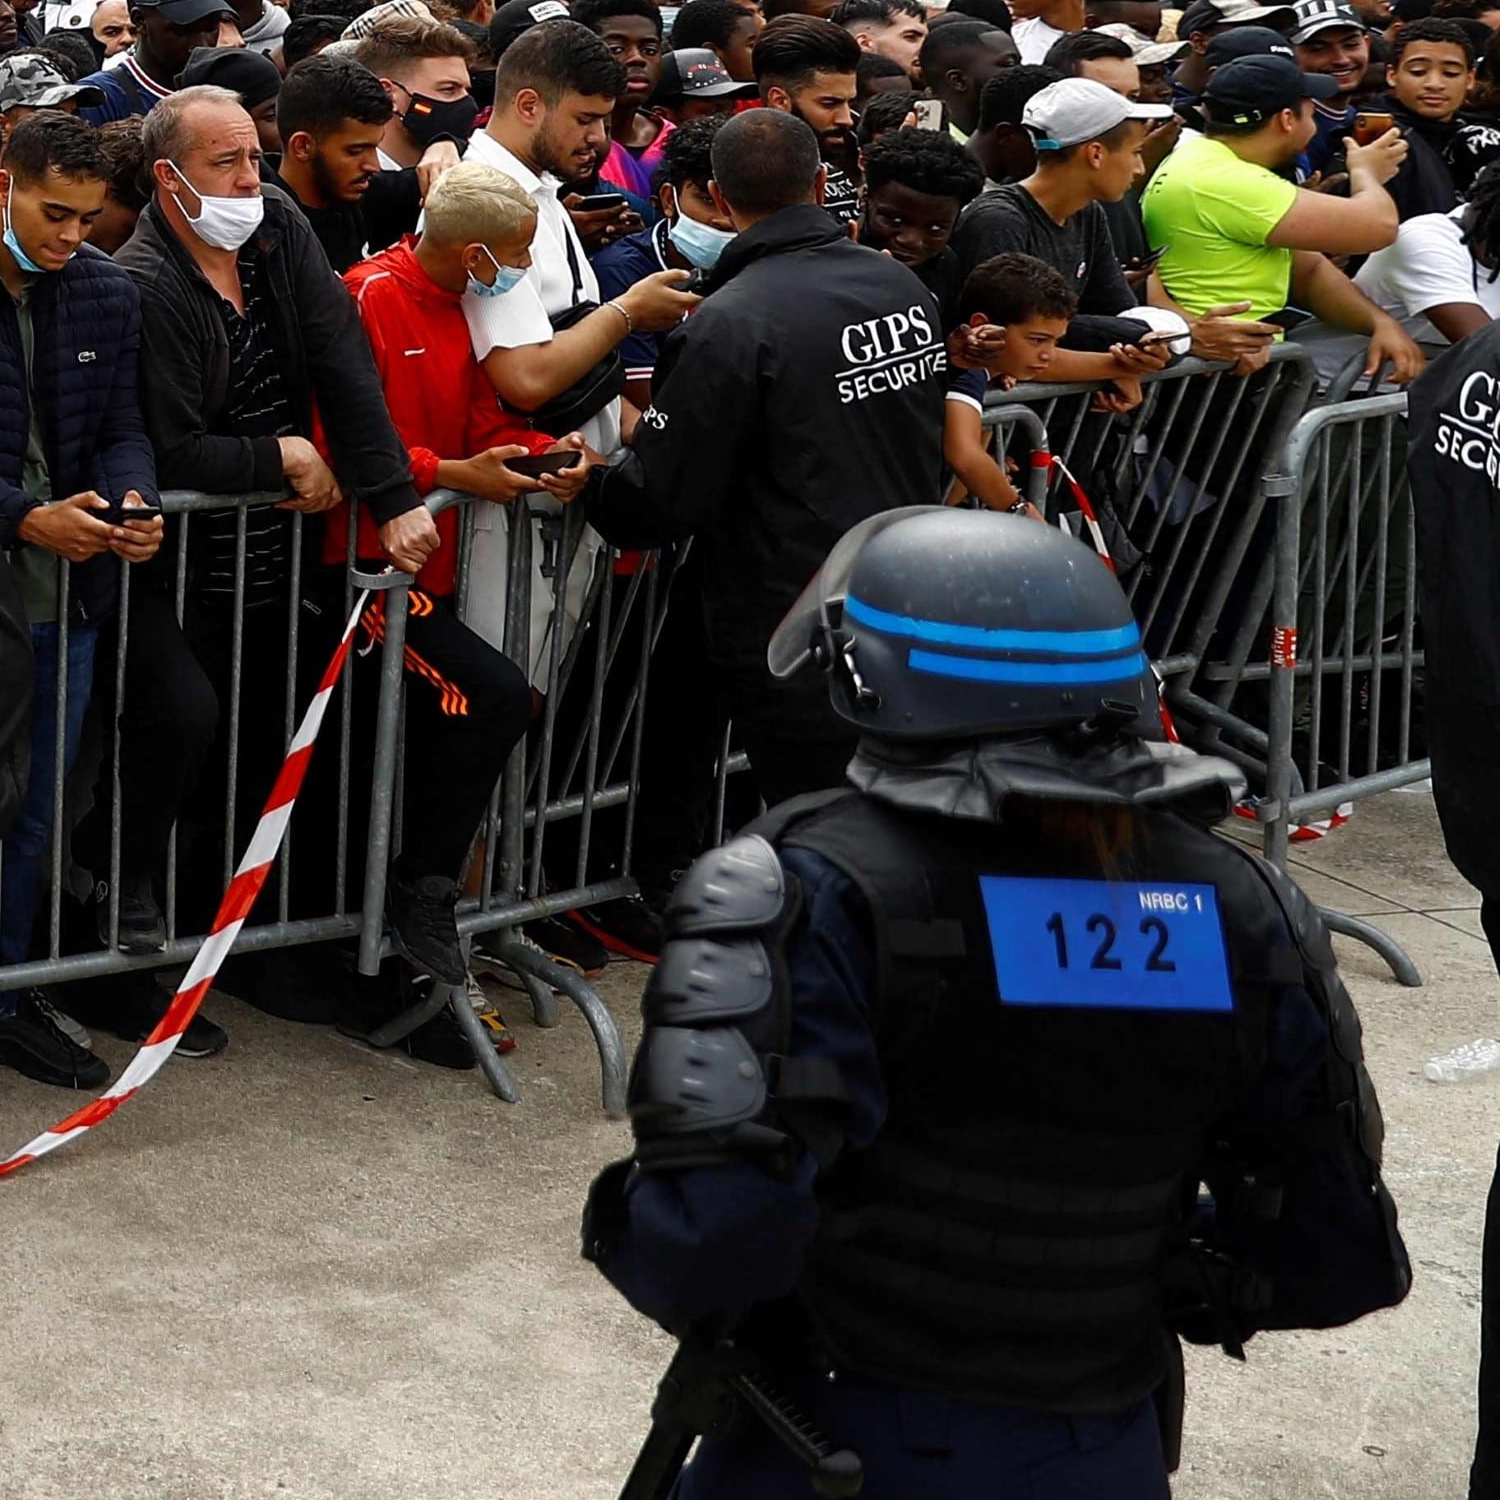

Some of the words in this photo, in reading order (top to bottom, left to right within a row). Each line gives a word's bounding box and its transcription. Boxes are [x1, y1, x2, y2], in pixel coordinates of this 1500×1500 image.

[841, 305, 933, 364] GIPS
[838, 351, 947, 404] SECURITE
[1139, 892, 1188, 912] NRBC
[1193, 894, 1202, 912] 1
[1046, 912, 1176, 973] 122
